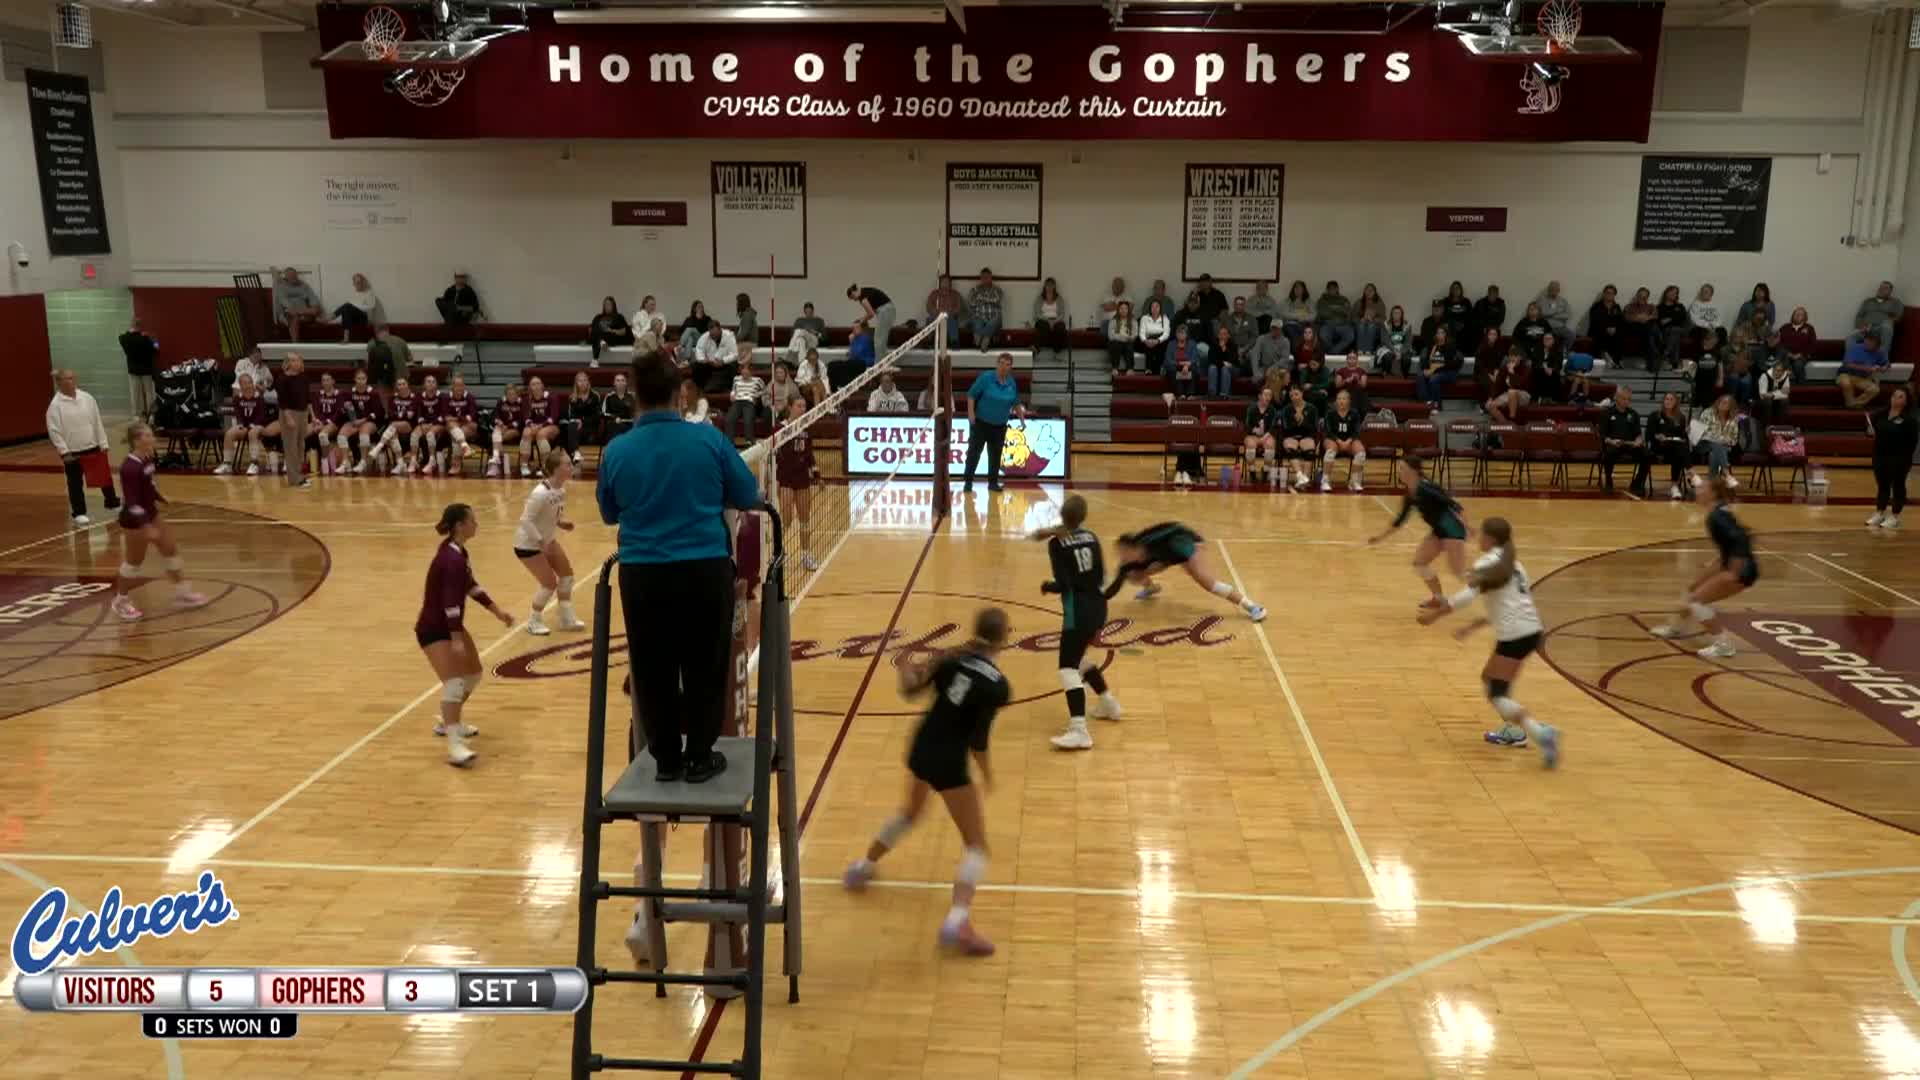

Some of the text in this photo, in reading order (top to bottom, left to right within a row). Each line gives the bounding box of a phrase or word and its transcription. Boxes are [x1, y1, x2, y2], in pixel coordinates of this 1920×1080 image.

[548, 43, 1411, 95] Home of the Gophers
[704, 94, 1226, 122] CVHS Class of 1960 Donated this Curtain
[979, 168, 1038, 179] BASKETBALL
[1659, 163, 1702, 171] CHATFIELD
[716, 166, 802, 194] VOLLEYBALL
[1190, 168, 1280, 197] WRESTLING
[632, 209, 666, 217] VISITORS
[1449, 215, 1484, 223] VISITORS
[951, 225, 1038, 236] GIRLS BASKETBALL
[854, 427, 968, 444] CHATFL
[863, 447, 968, 464] GOPHR
